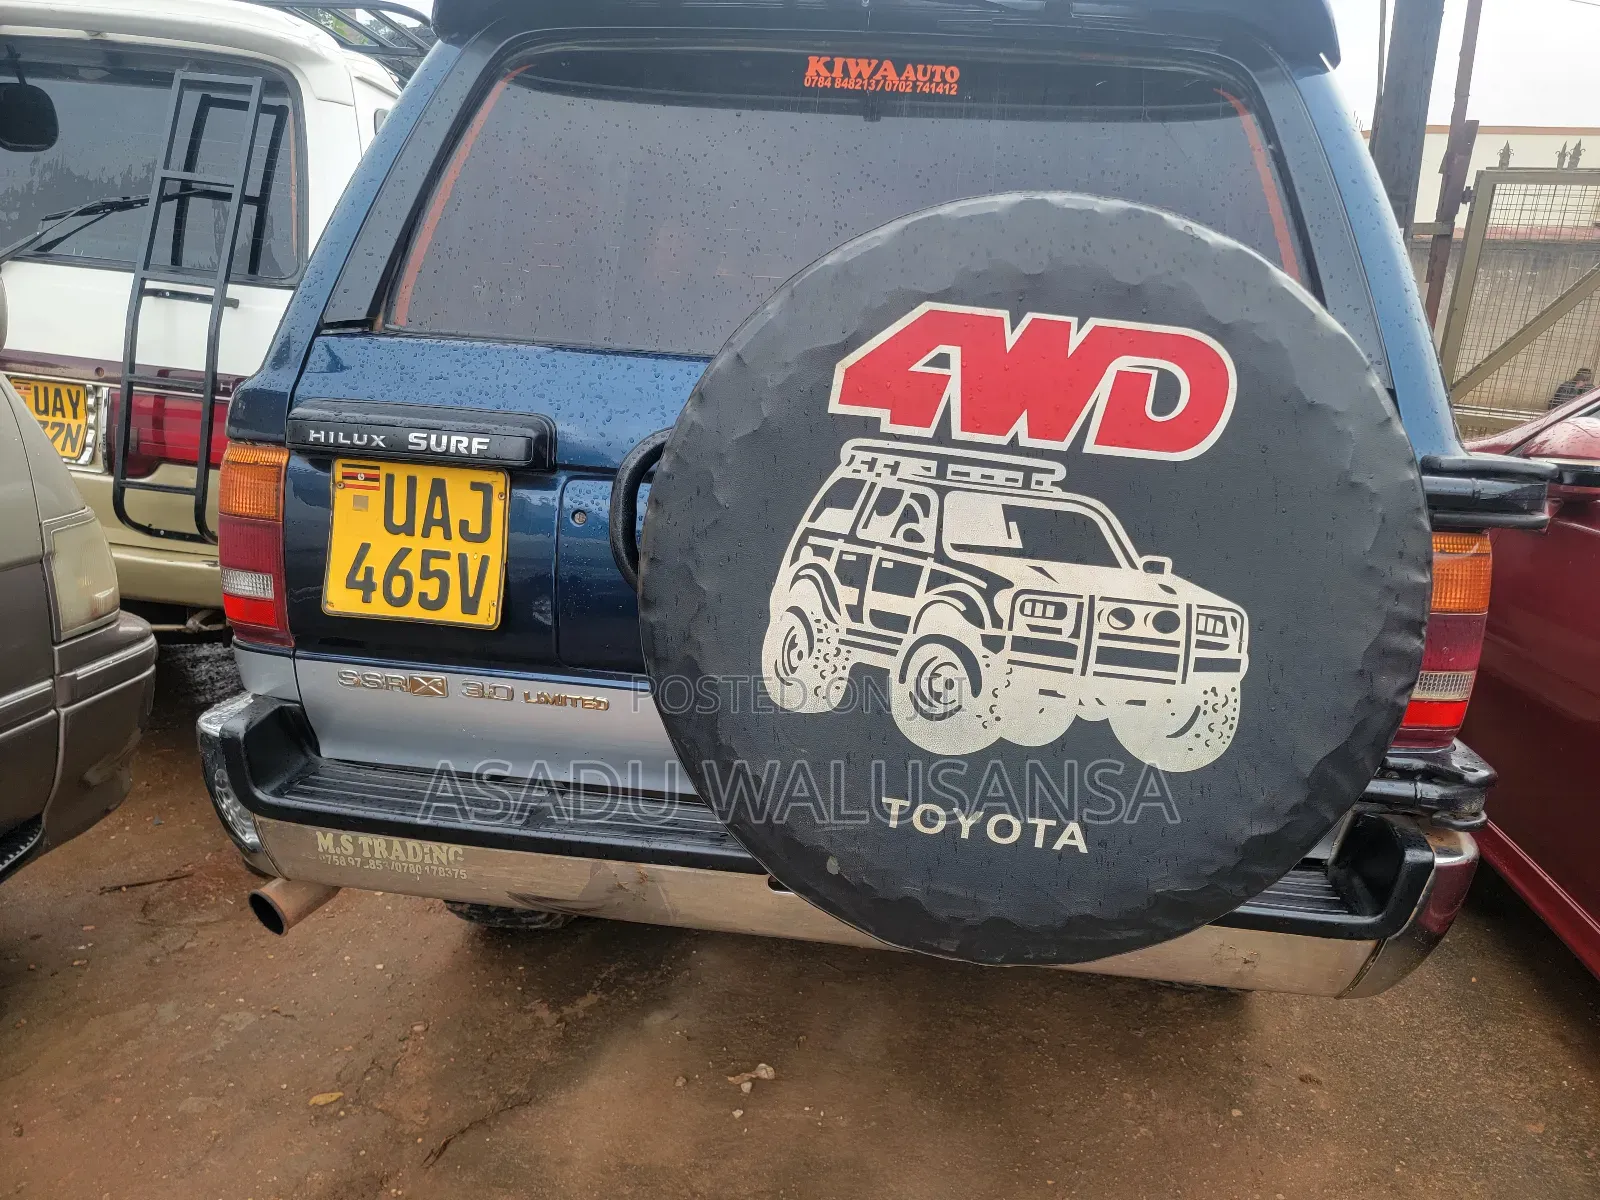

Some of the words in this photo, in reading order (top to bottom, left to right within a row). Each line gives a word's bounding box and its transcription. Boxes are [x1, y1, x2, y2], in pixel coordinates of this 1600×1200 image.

[804, 76, 832, 89] 0784
[916, 82, 958, 96] 741412
[805, 56, 900, 81] KIWA
[901, 63, 961, 83] AUTO
[828, 301, 1238, 462] 4WD
[33, 385, 81, 420] UAY
[308, 429, 387, 448] HILUX
[407, 432, 491, 454] SURF
[383, 473, 494, 543] UAJ
[345, 542, 491, 615] 465V
[461, 679, 515, 702] 3.0
[523, 690, 610, 711] LIMITED
[881, 796, 1089, 854] TOYOTA
[316, 830, 354, 856] M.S
